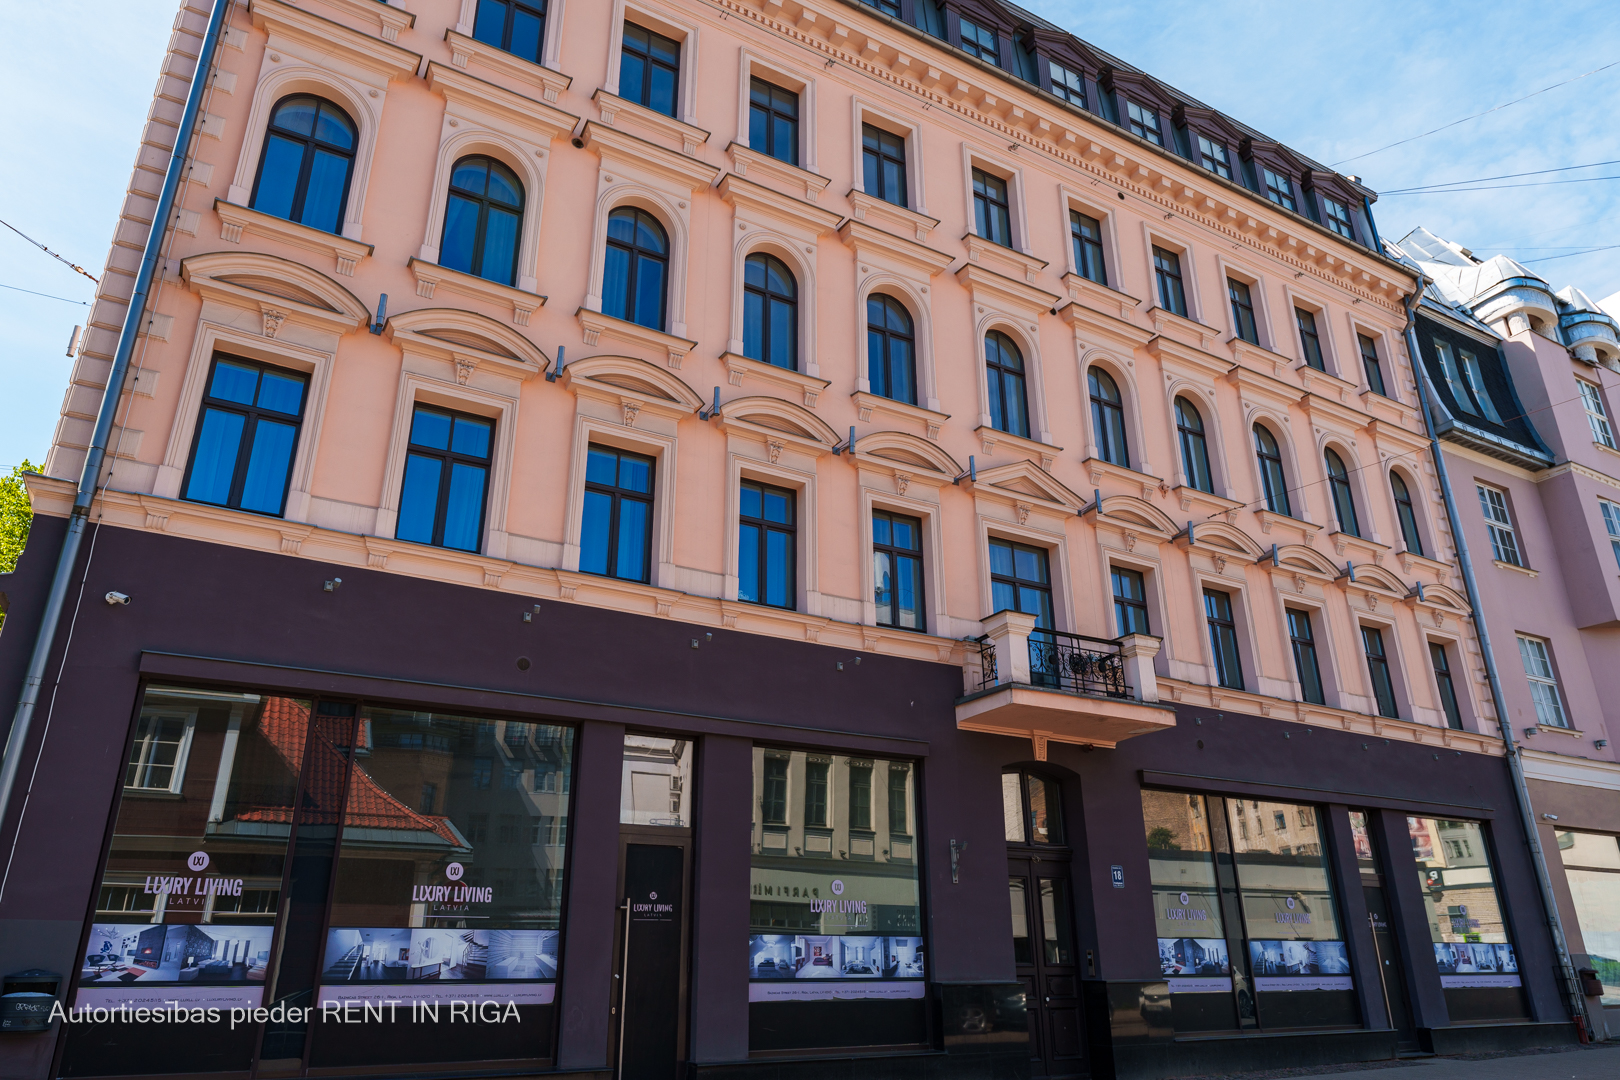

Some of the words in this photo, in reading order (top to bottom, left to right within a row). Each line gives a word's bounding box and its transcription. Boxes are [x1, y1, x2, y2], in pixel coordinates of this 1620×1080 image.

[1113, 870, 1122, 881] 18
[144, 876, 194, 895] LUXURY
[194, 877, 244, 897] LIVING
[412, 885, 452, 902] LUXURY
[453, 886, 493, 903] LIVING
[633, 903, 653, 912] LUXURY
[653, 904, 673, 913] LIVING
[810, 899, 837, 913] LUXURY
[839, 900, 867, 914] LIVING
[1187, 909, 1207, 921] LIVING
